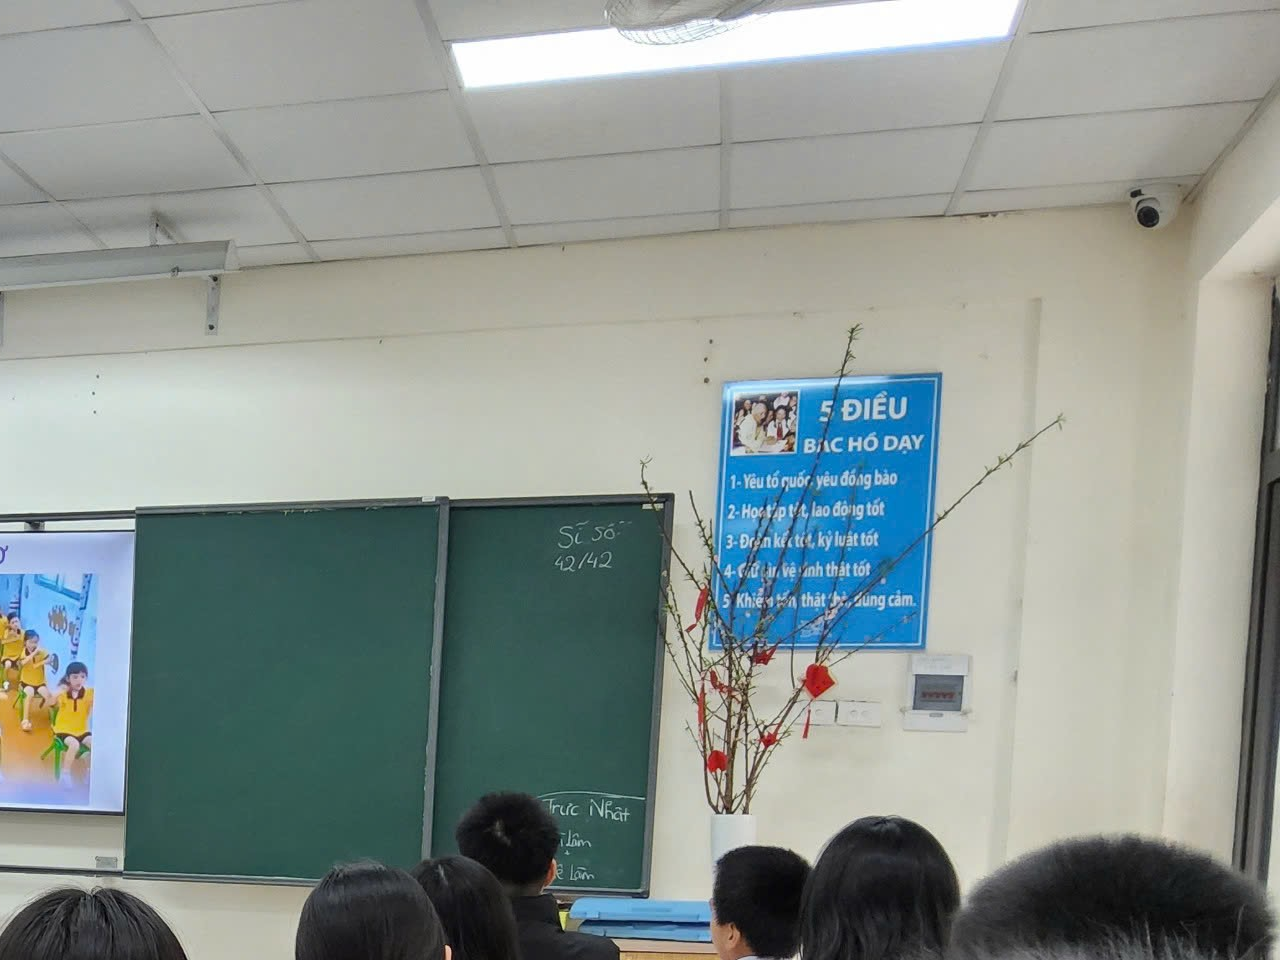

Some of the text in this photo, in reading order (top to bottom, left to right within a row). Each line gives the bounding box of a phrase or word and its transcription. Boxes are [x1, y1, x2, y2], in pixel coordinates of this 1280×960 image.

[819, 391, 908, 422] 5 ĐIỀU
[883, 434, 925, 455] DẠY
[744, 472, 763, 489] Yêu
[816, 472, 838, 490] yêu
[811, 502, 830, 517] lao
[866, 499, 885, 516] tốt
[861, 529, 879, 546] tốt
[554, 551, 613, 573] 42/42
[801, 591, 826, 612] thật
